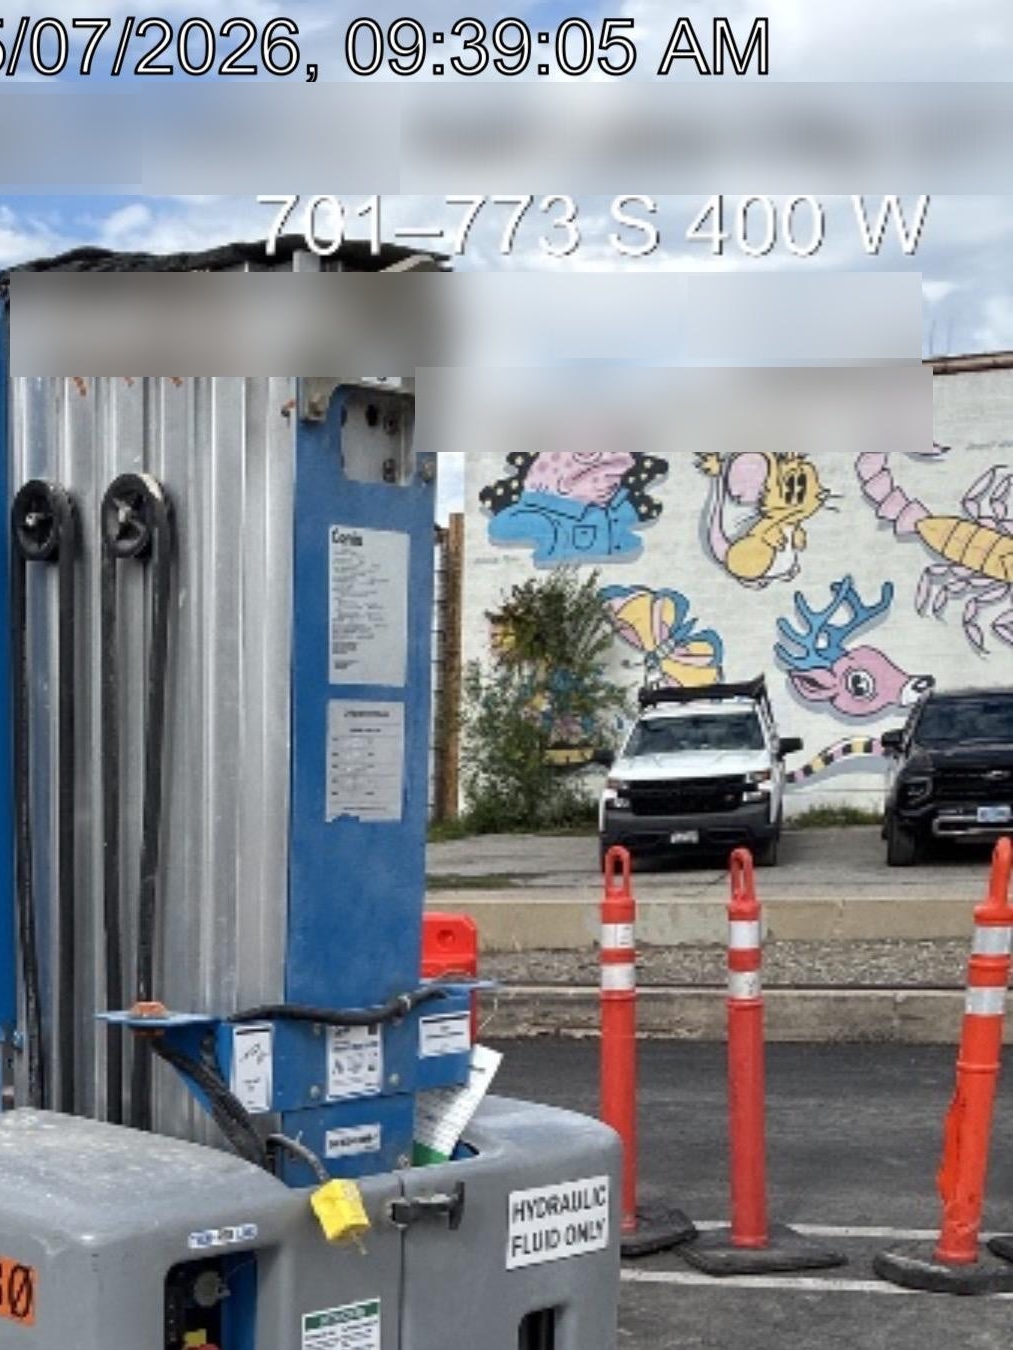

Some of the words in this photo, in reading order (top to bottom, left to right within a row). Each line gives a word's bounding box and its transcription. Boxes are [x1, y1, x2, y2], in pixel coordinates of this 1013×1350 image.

[511, 1184, 608, 1225] HYDRAULIC
[510, 1226, 561, 1258] FLUID
[564, 1216, 606, 1248] ONLY
